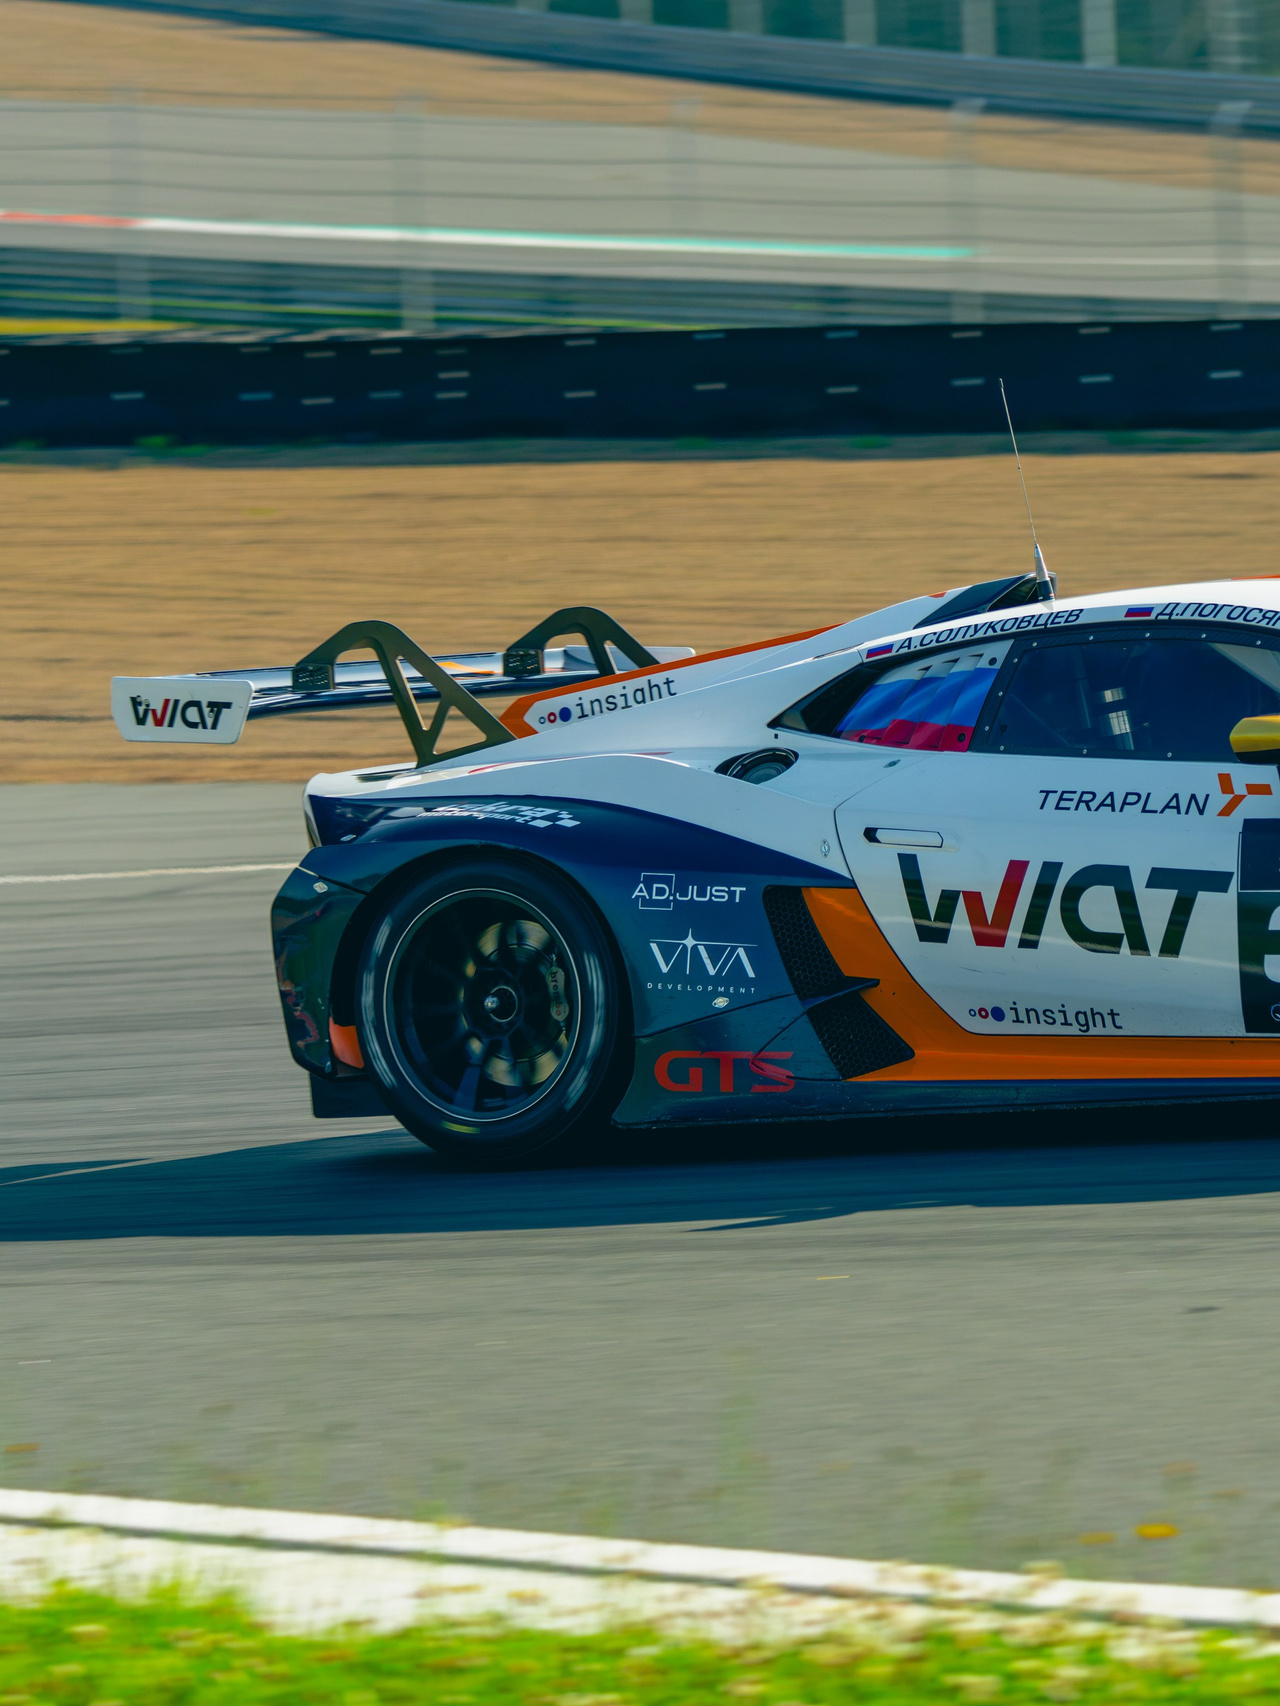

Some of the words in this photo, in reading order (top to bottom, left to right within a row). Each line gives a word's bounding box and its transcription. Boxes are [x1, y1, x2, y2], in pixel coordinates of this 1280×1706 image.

[896, 608, 1084, 653] А.СОЛУКОВЦЕВ
[576, 677, 677, 719] insight
[1037, 789, 1210, 816] TERAPLAN
[649, 931, 757, 978] VIVA
[647, 982, 756, 994] DEVELOPMENT
[1009, 1001, 1123, 1033] insight
[654, 1050, 796, 1092] GTS
